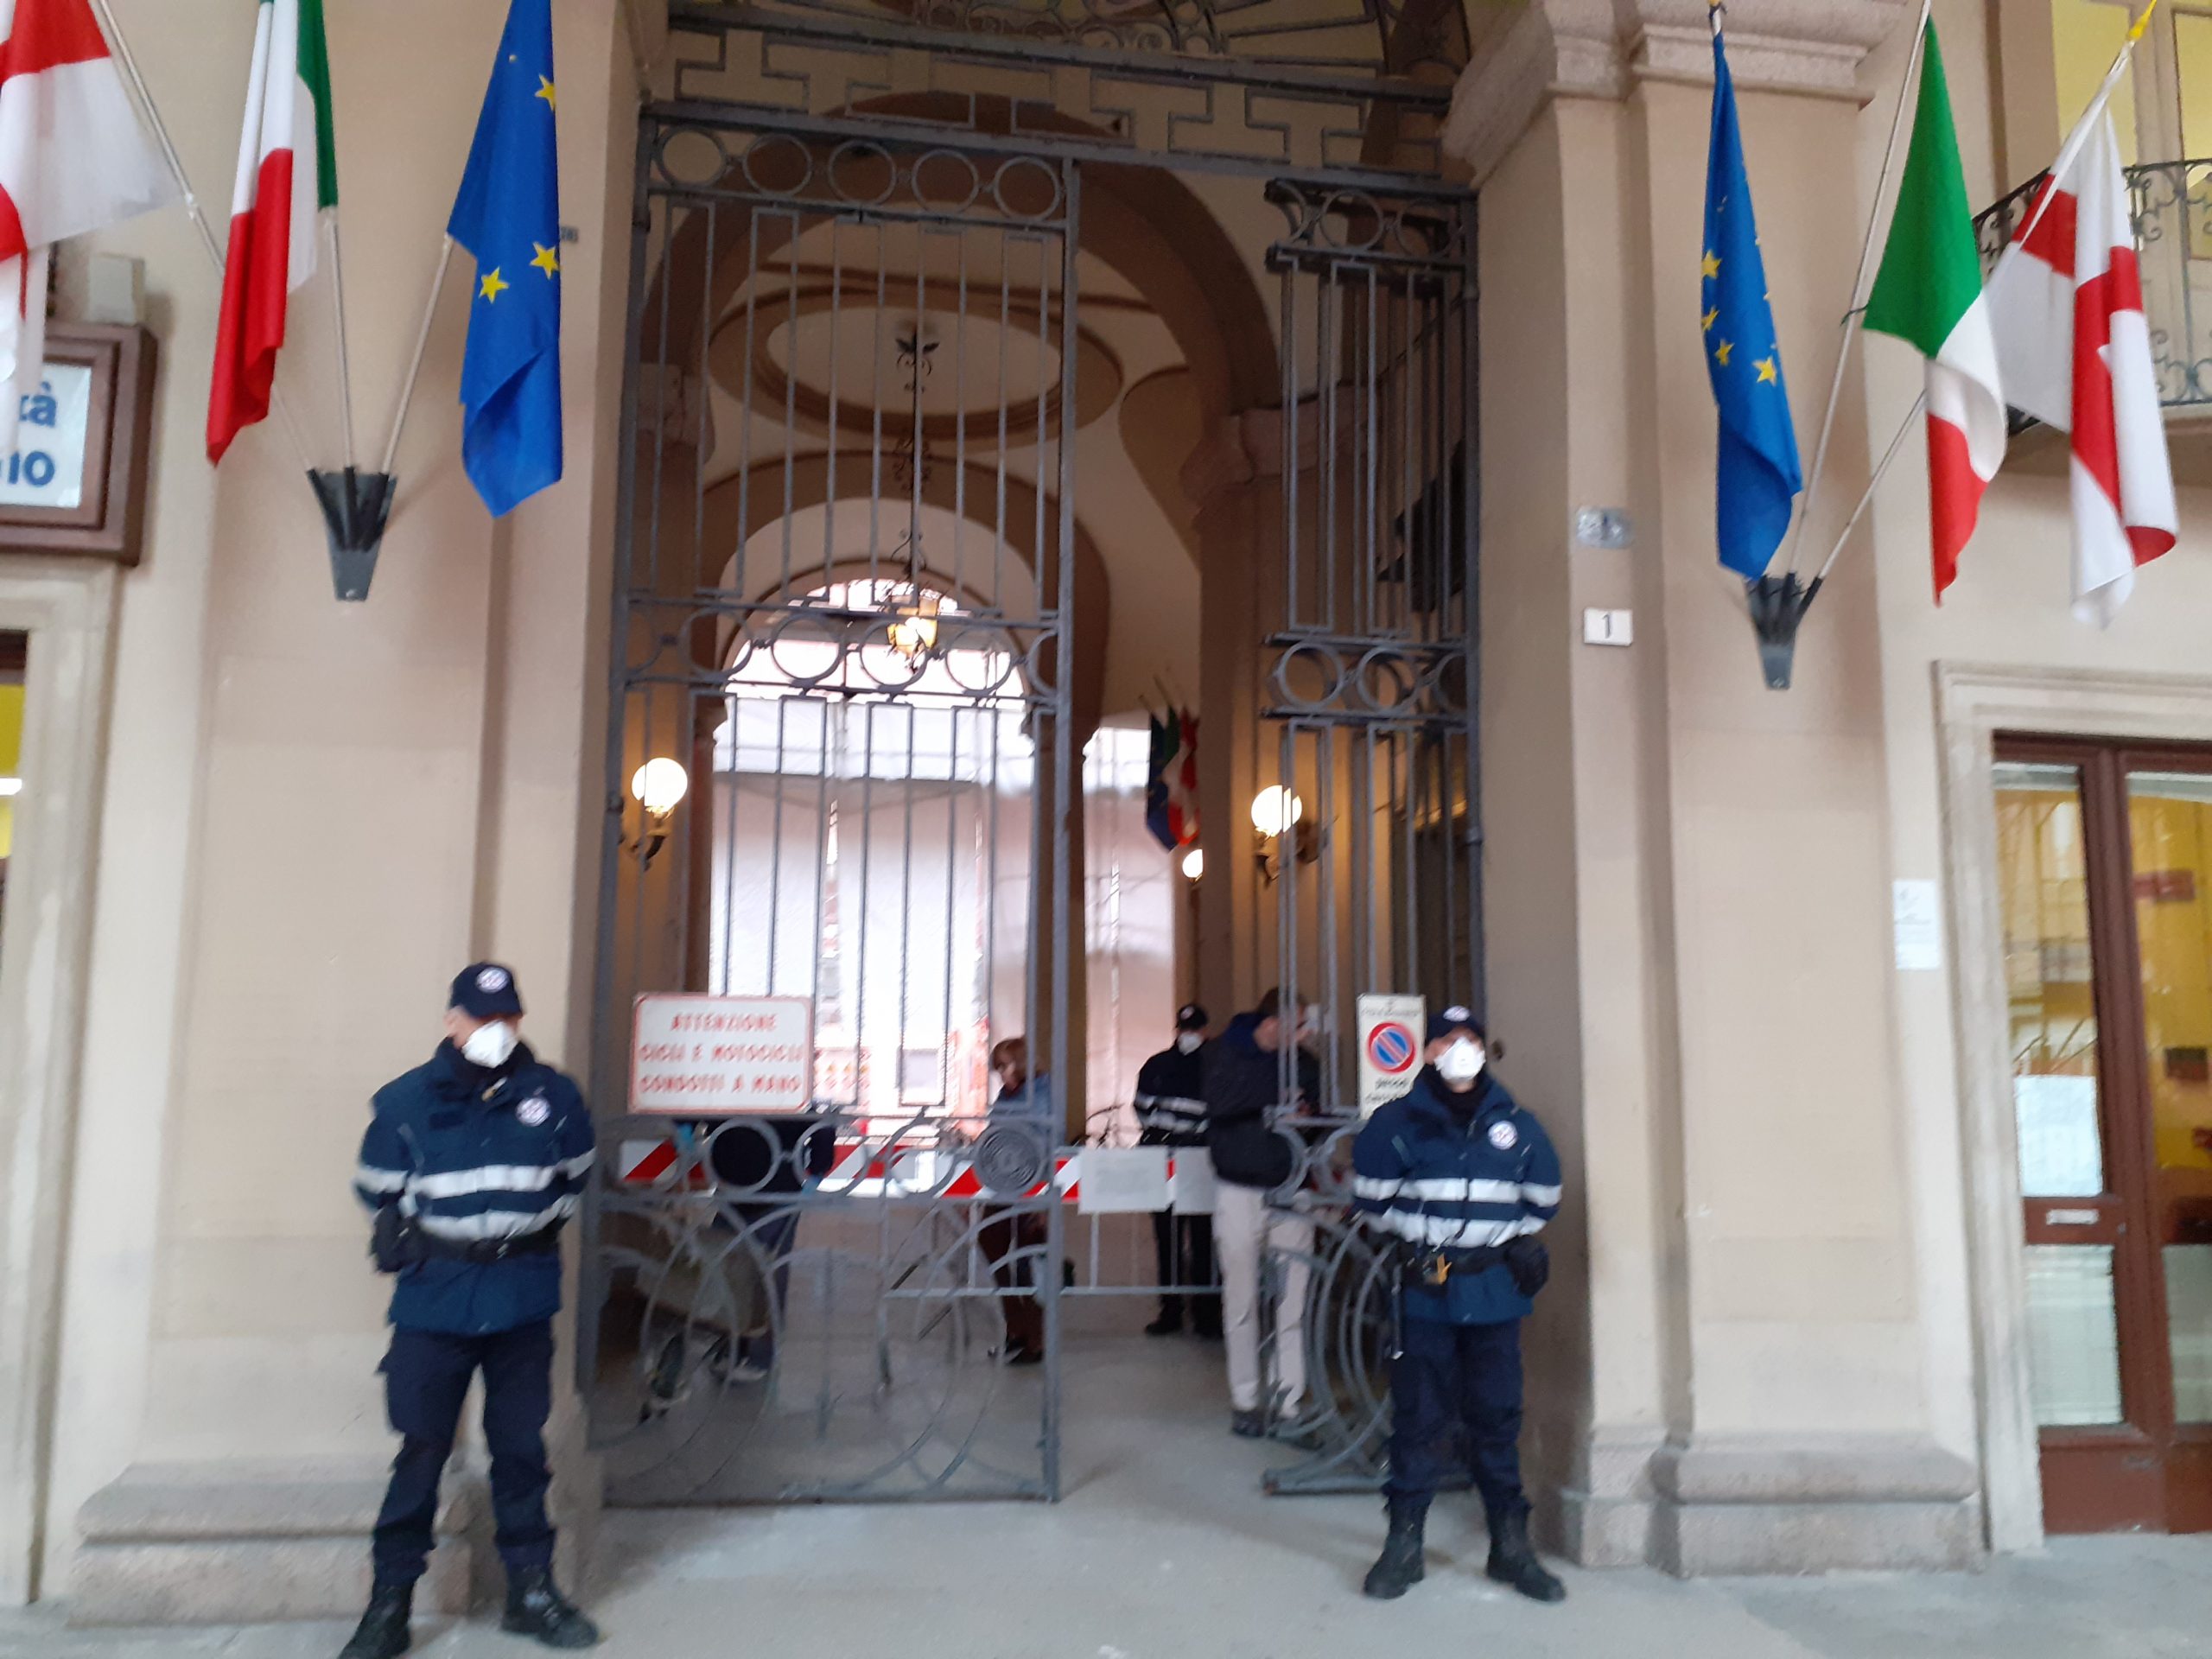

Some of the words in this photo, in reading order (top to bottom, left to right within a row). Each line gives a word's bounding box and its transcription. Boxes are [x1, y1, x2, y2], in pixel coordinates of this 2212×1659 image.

[1601, 612, 1611, 639] 1
[671, 1013, 778, 1031] ATTENZIONE
[692, 1043, 703, 1062] E
[732, 1074, 745, 1092] A
[751, 1074, 801, 1093] MANO
